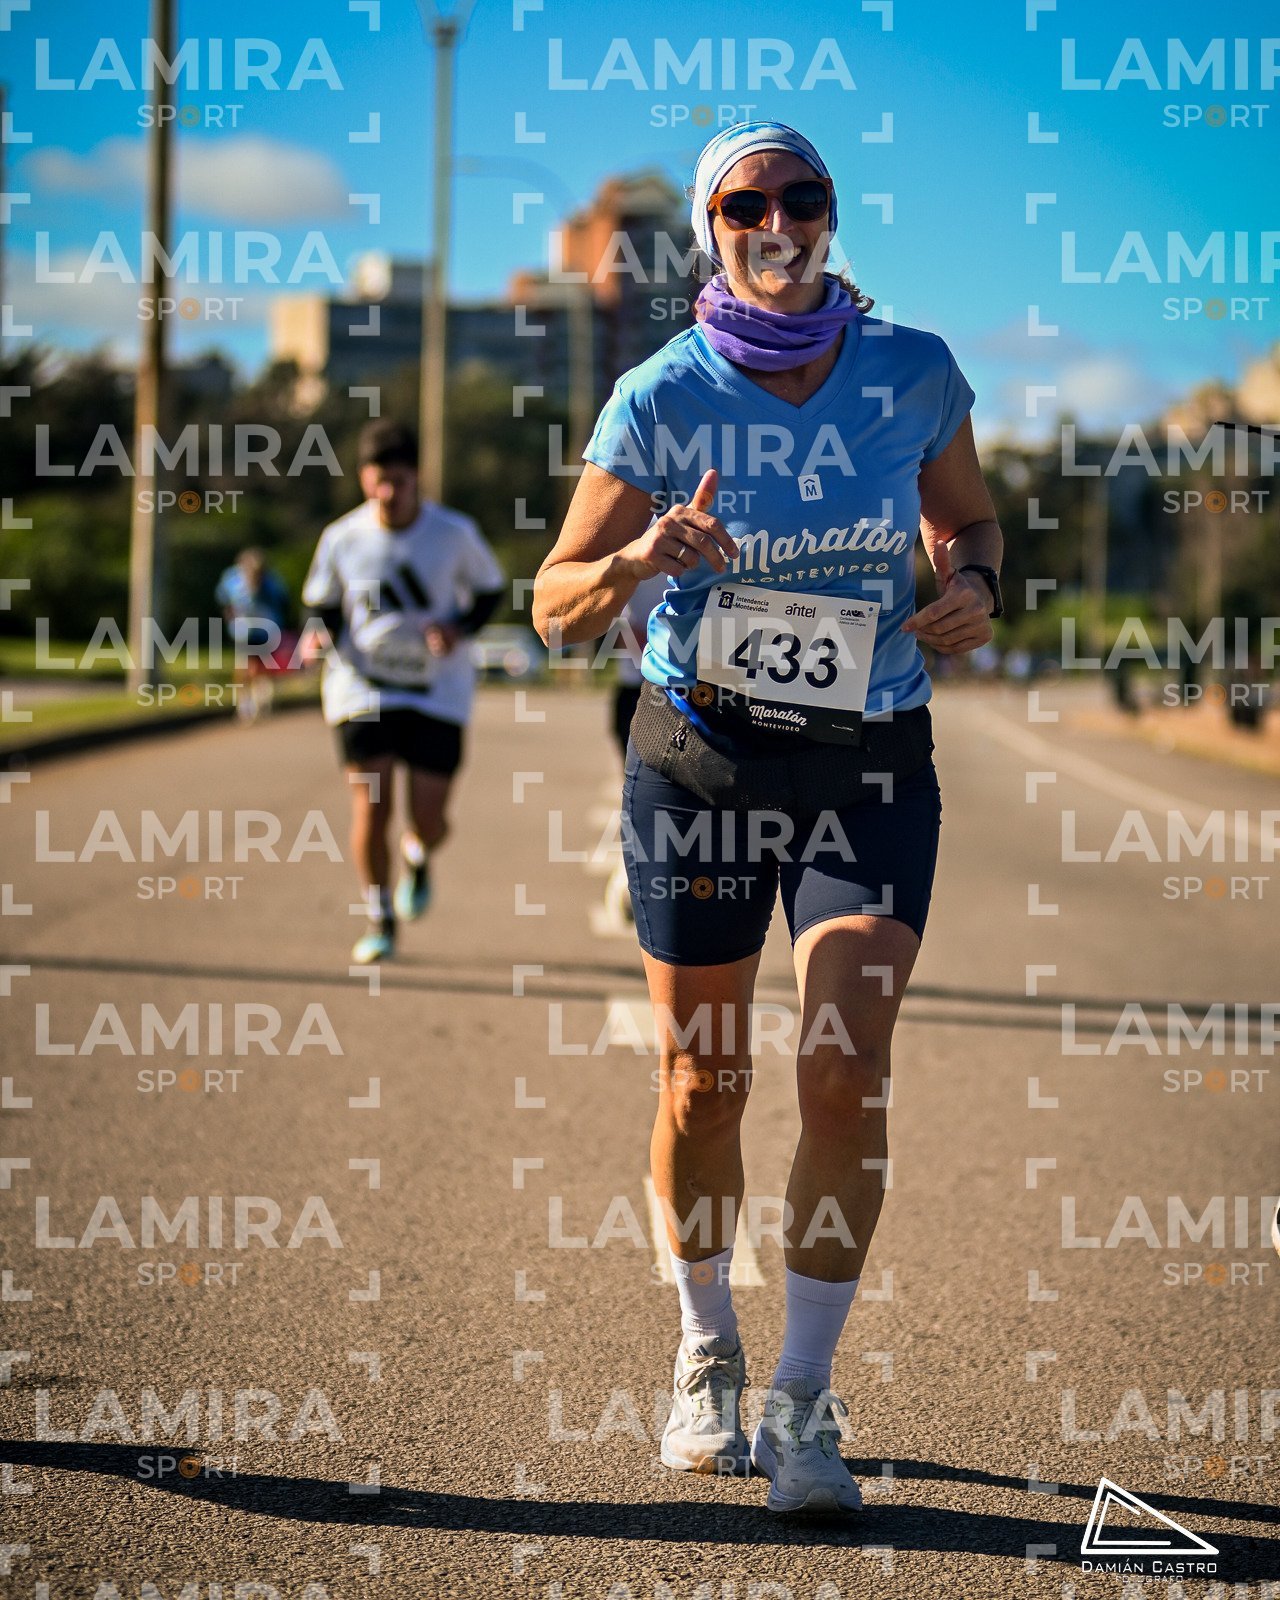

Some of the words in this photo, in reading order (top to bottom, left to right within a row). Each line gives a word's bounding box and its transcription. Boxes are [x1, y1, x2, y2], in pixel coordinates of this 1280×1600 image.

[721, 518, 908, 574] Maratón
[741, 562, 890, 584] MONTEVIDEO
[785, 603, 817, 619] antel
[728, 629, 838, 689] 433
[749, 705, 807, 726] Maratón
[751, 719, 800, 732] MONTEVIDEO
